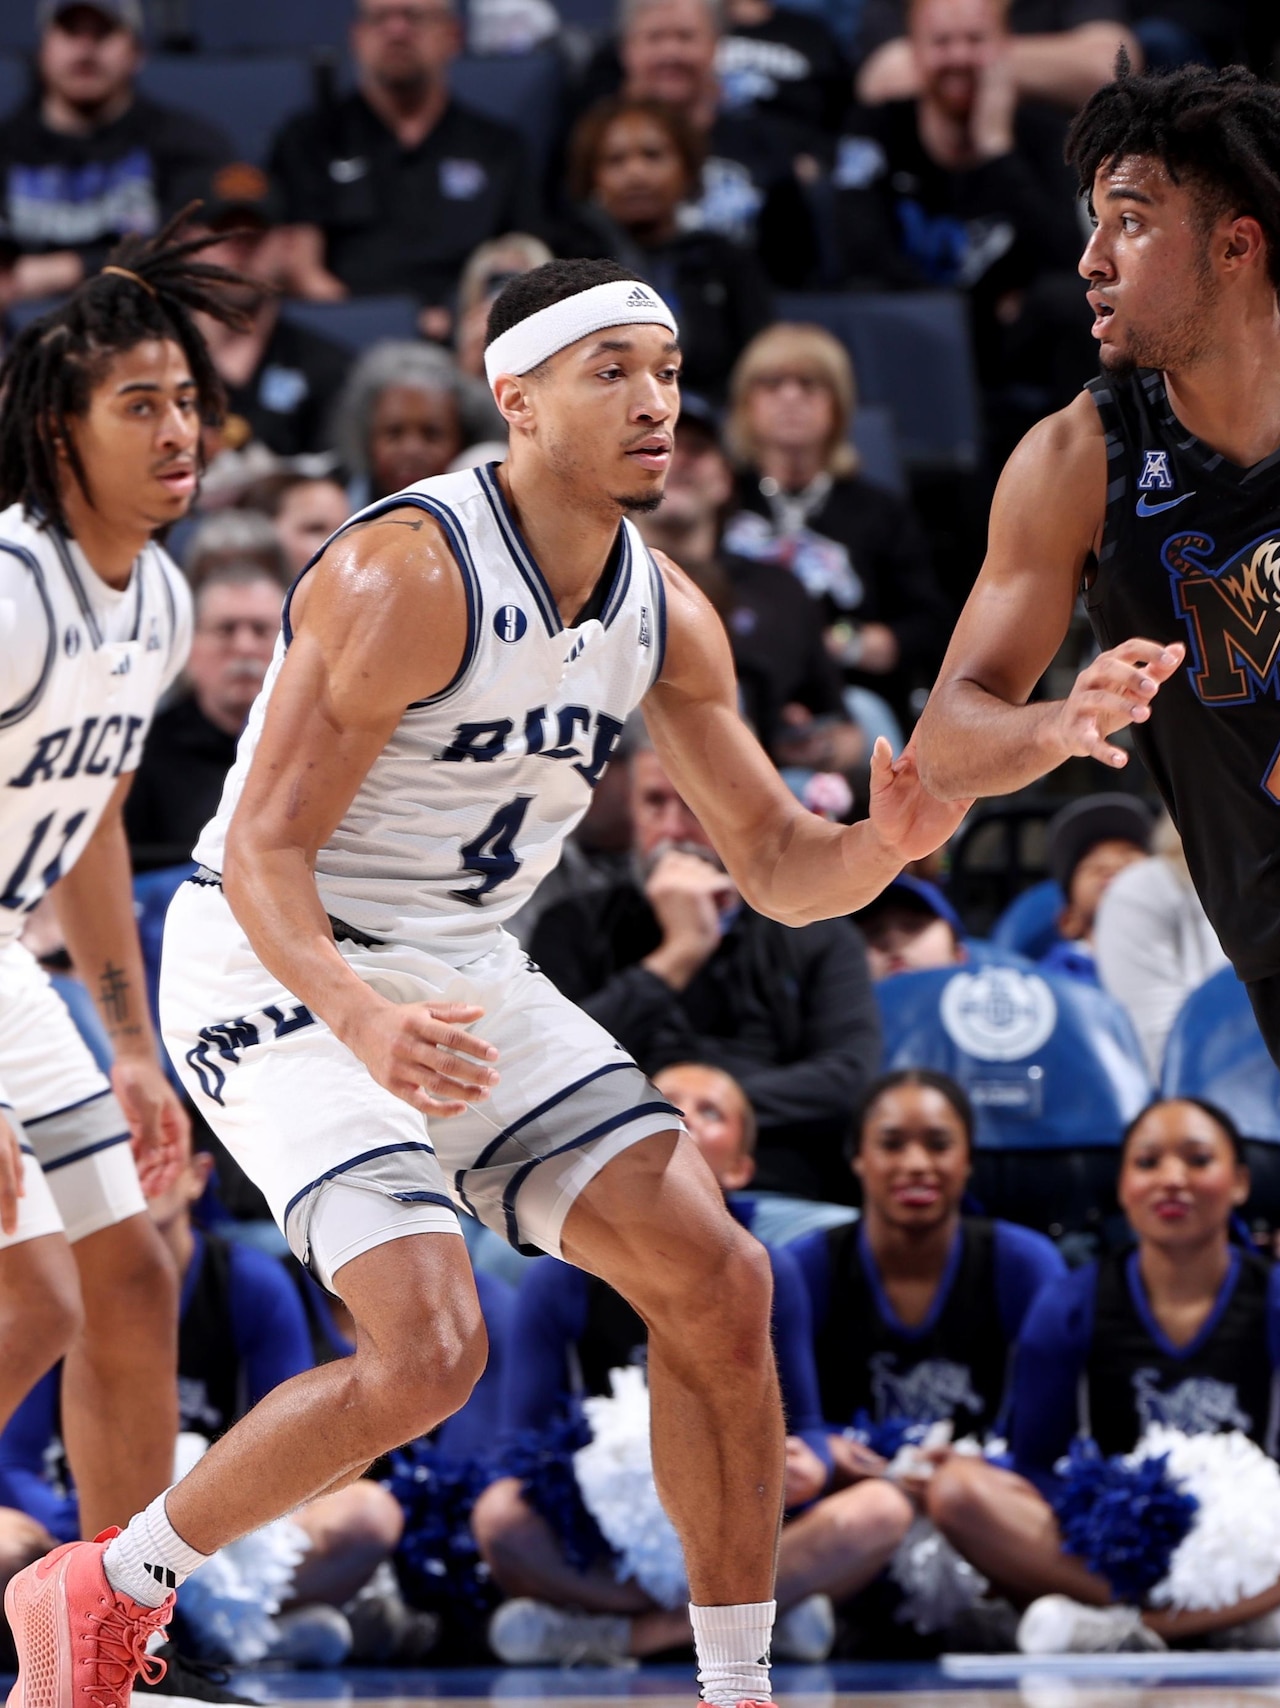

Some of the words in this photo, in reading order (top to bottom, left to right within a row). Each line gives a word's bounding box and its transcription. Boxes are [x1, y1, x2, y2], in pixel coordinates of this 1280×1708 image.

[6, 714, 144, 788] RICE
[432, 703, 625, 789] RICE
[447, 793, 536, 907] 4
[185, 1004, 319, 1108] OWL
